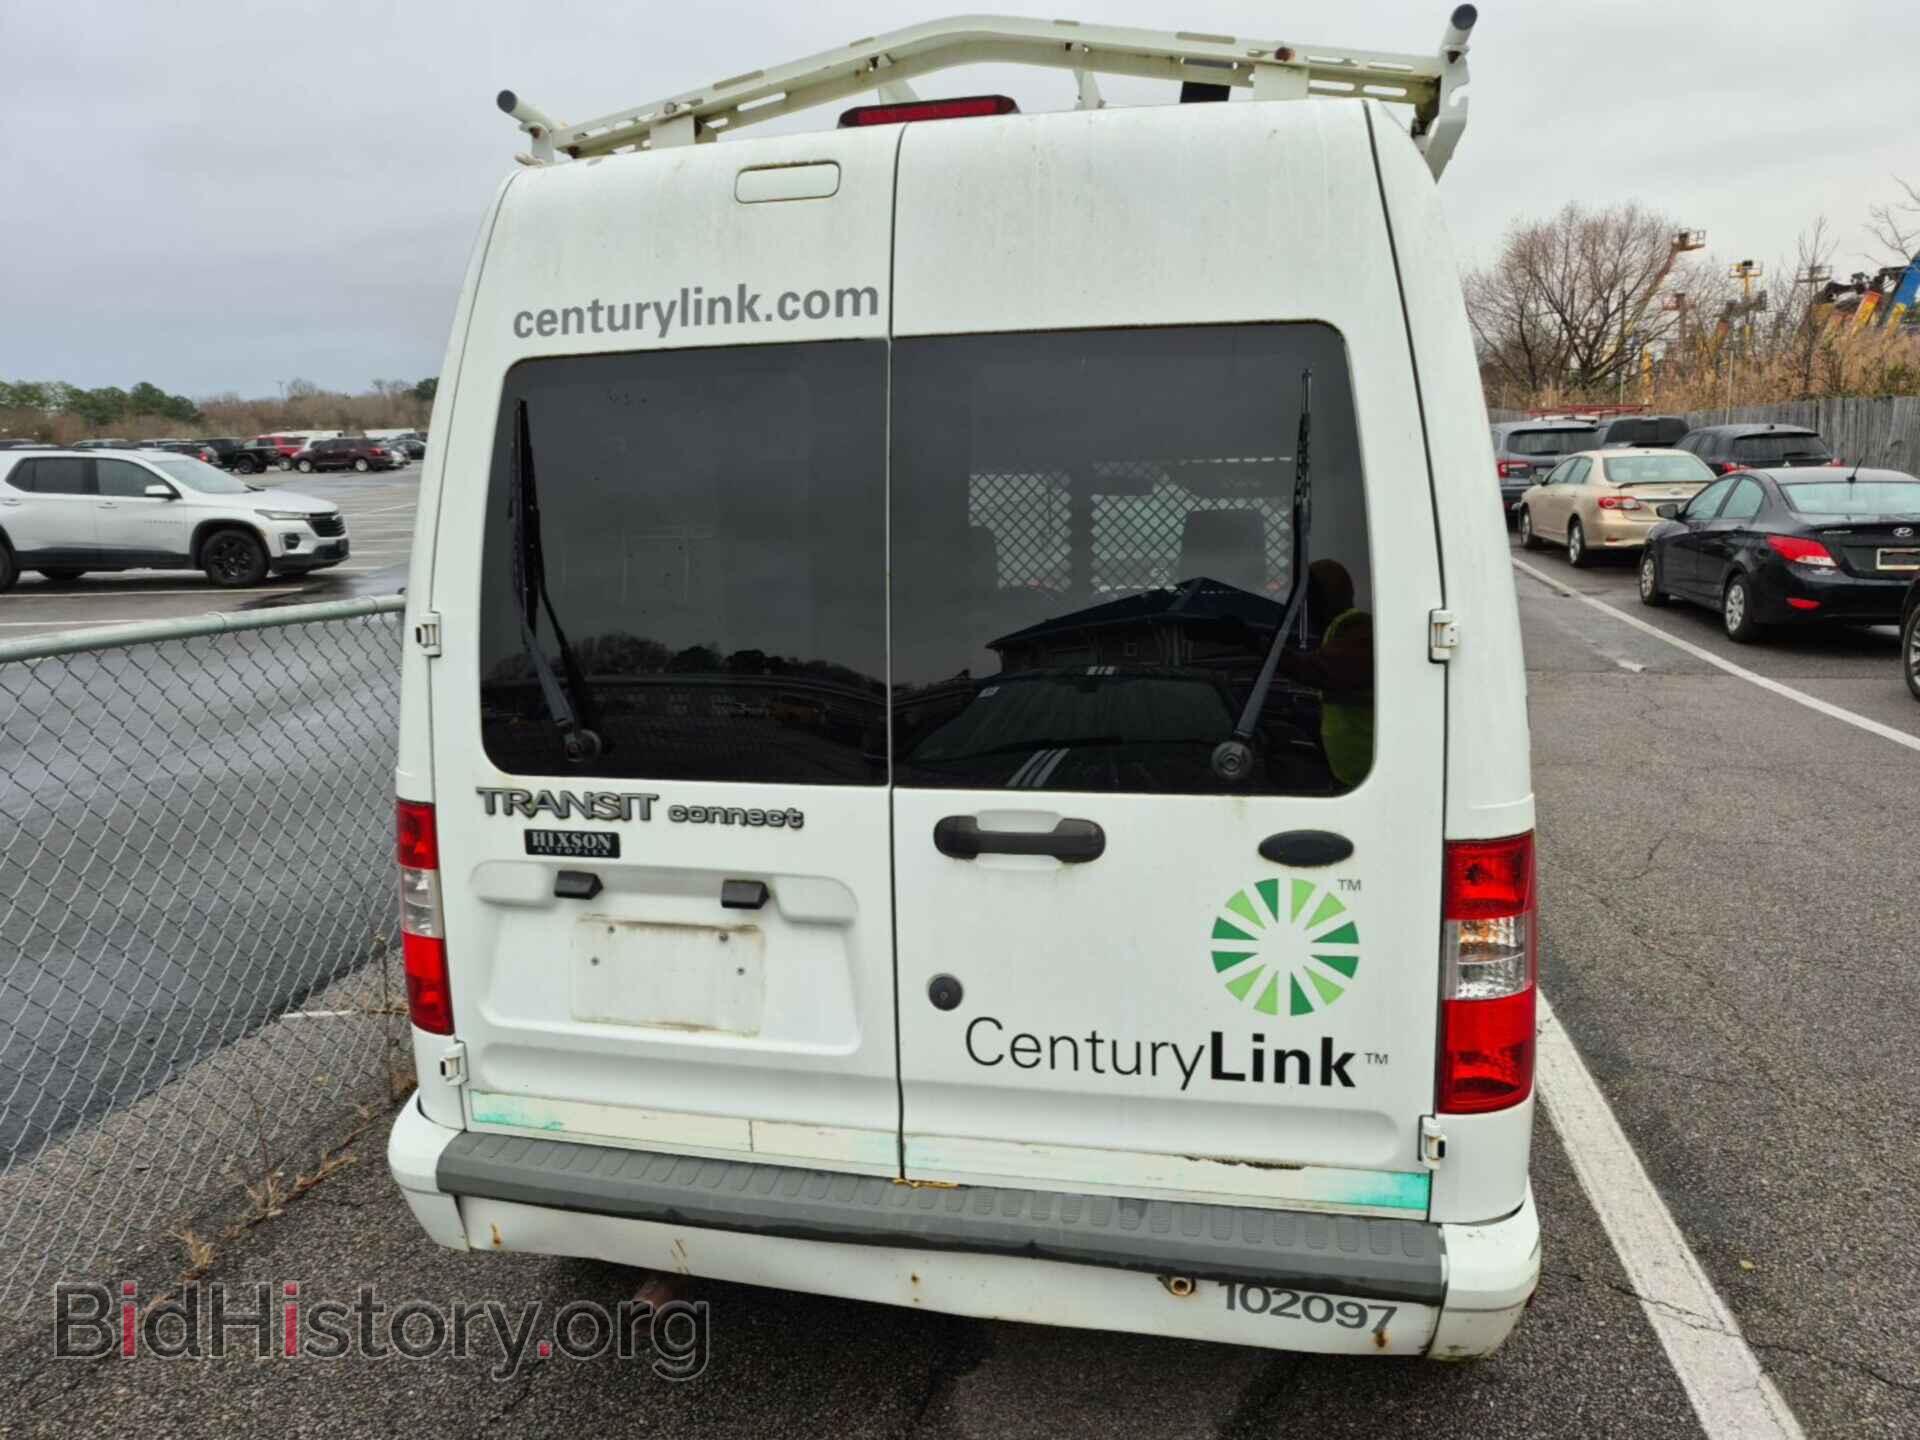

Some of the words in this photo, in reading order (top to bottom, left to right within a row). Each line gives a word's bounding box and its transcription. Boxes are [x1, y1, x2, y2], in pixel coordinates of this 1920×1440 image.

[513, 284, 879, 338] centurylink.com
[475, 787, 660, 821] TRANSIT
[668, 804, 805, 829] connect
[532, 832, 612, 850] HIXSON
[966, 1017, 1356, 1091] CenturyLink
[1219, 1281, 1398, 1333] 102097
